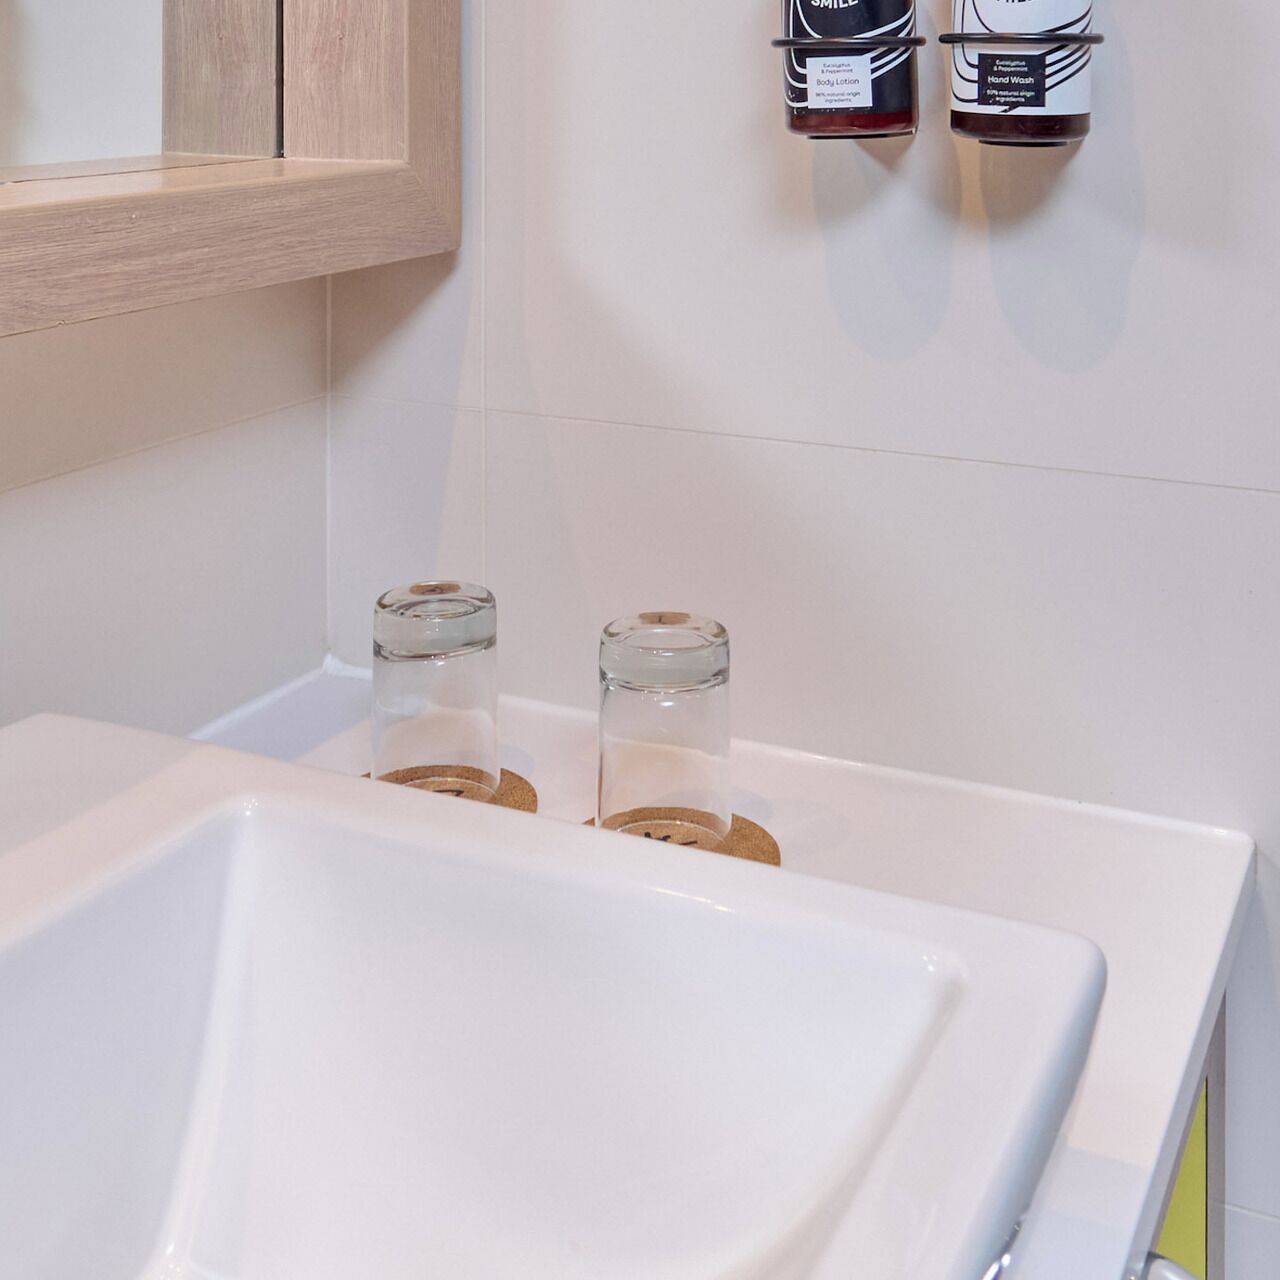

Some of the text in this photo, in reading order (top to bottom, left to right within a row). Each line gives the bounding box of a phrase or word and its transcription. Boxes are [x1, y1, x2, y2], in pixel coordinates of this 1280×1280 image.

[816, 77, 860, 87] Body Lotion
[987, 75, 1035, 84] Hand Wash
